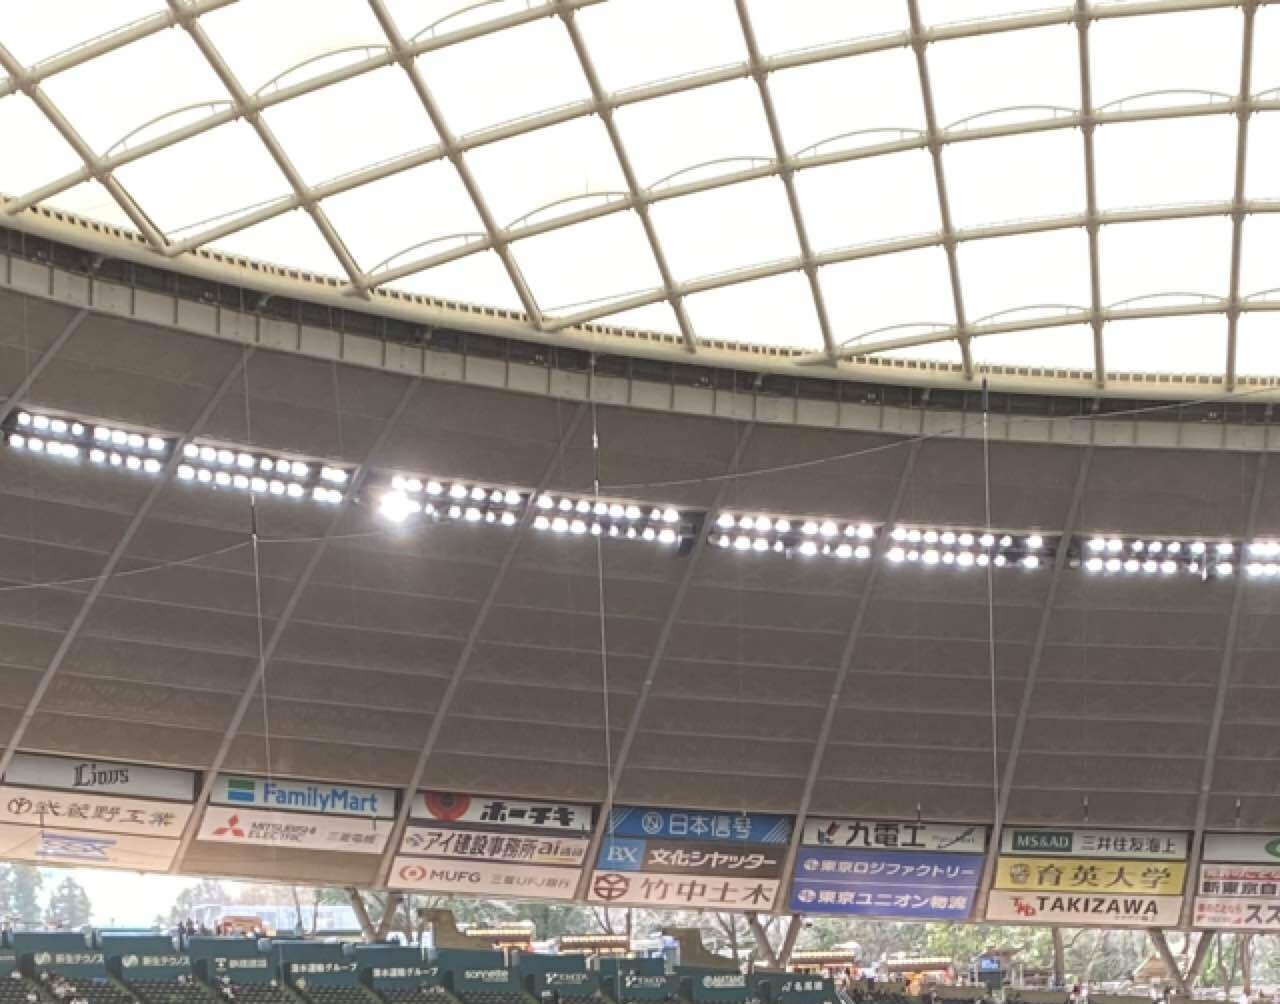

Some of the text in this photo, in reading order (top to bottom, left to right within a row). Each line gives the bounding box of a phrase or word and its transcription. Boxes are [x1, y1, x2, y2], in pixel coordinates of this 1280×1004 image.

[263, 783, 378, 813] FamilyMart
[480, 801, 575, 827] ホーチキ
[669, 813, 753, 840] 日本信号
[845, 821, 927, 848] 九電工
[1016, 834, 1071, 849] MS&AD
[607, 846, 638, 863] BX
[429, 869, 481, 884] MUFG
[1037, 863, 1172, 889] 育英大学
[640, 876, 774, 906] 竹中土木
[1037, 895, 1159, 916] TAKIZAWA
